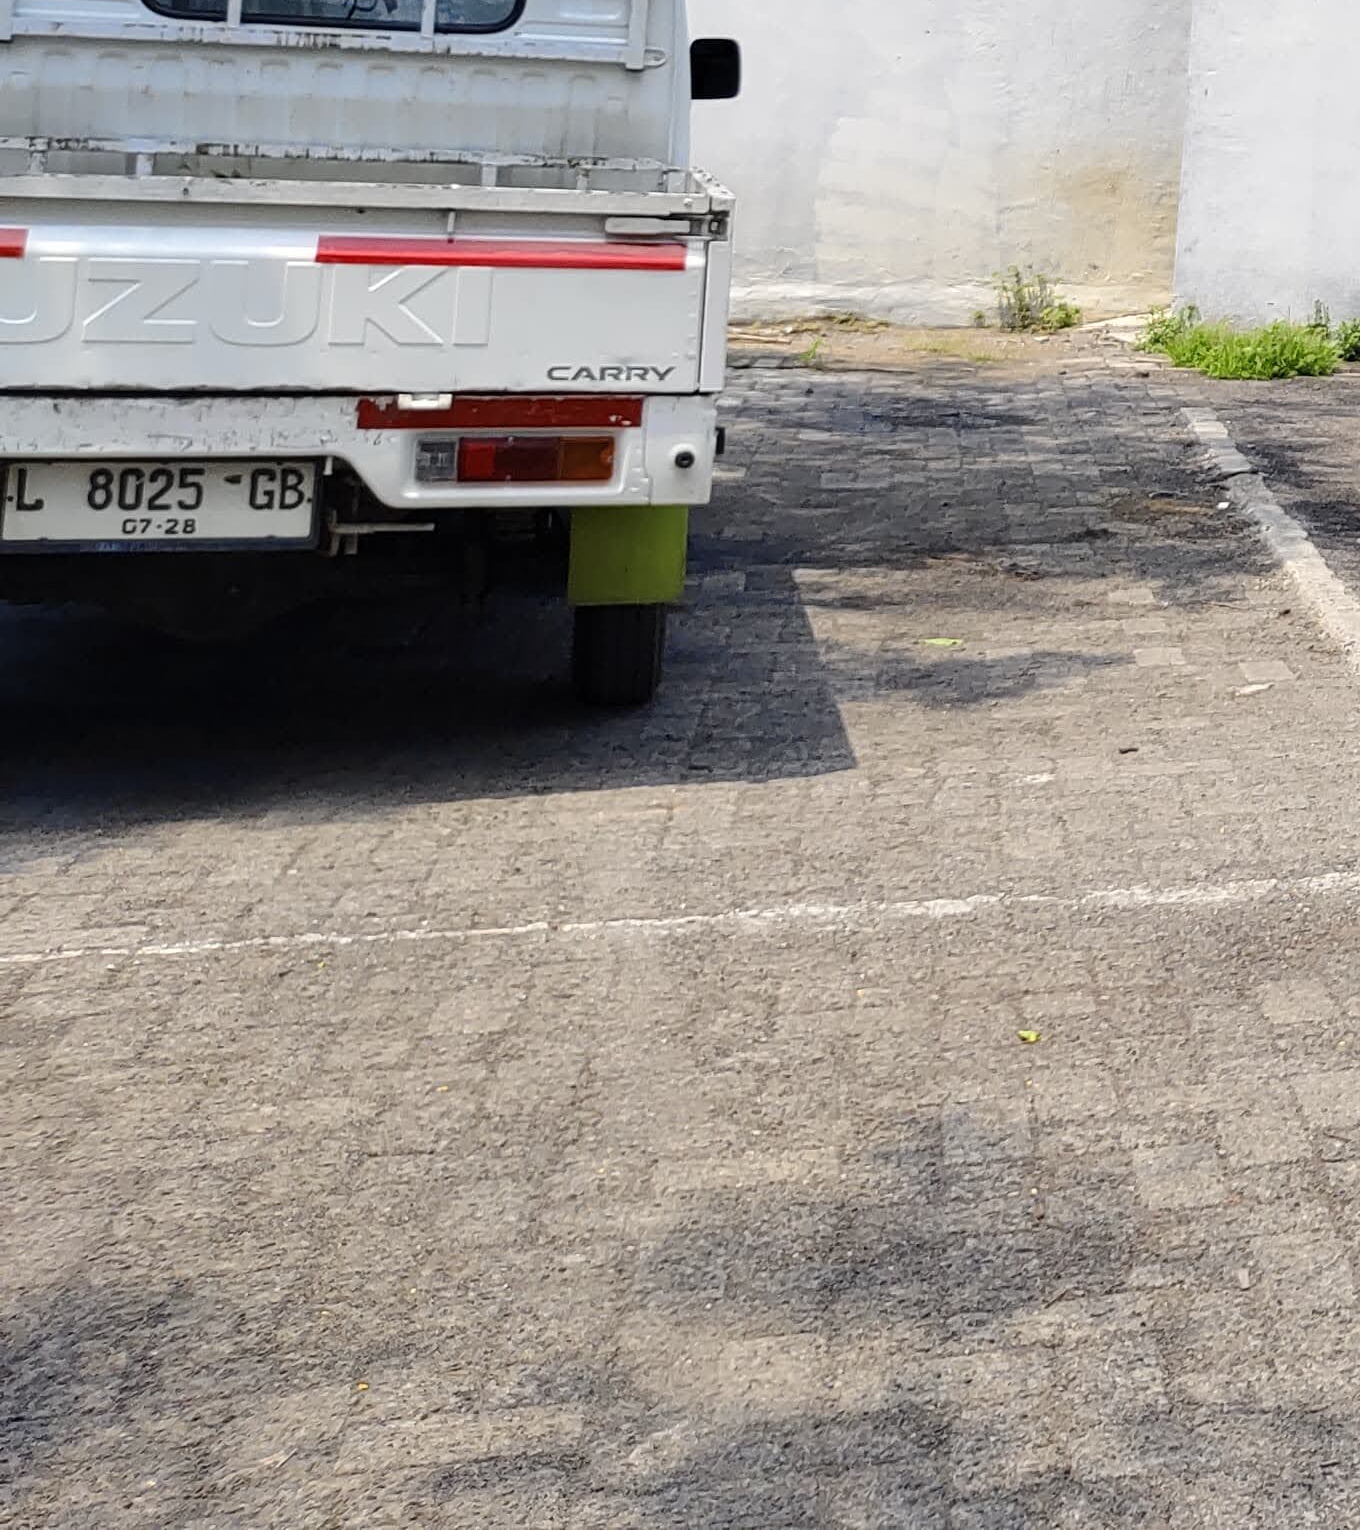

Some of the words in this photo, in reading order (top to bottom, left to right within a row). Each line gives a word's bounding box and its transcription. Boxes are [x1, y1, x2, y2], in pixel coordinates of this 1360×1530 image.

[546, 365, 677, 382] CARRY
[16, 468, 44, 511] L
[87, 468, 205, 511] 8025
[249, 468, 305, 510] GB
